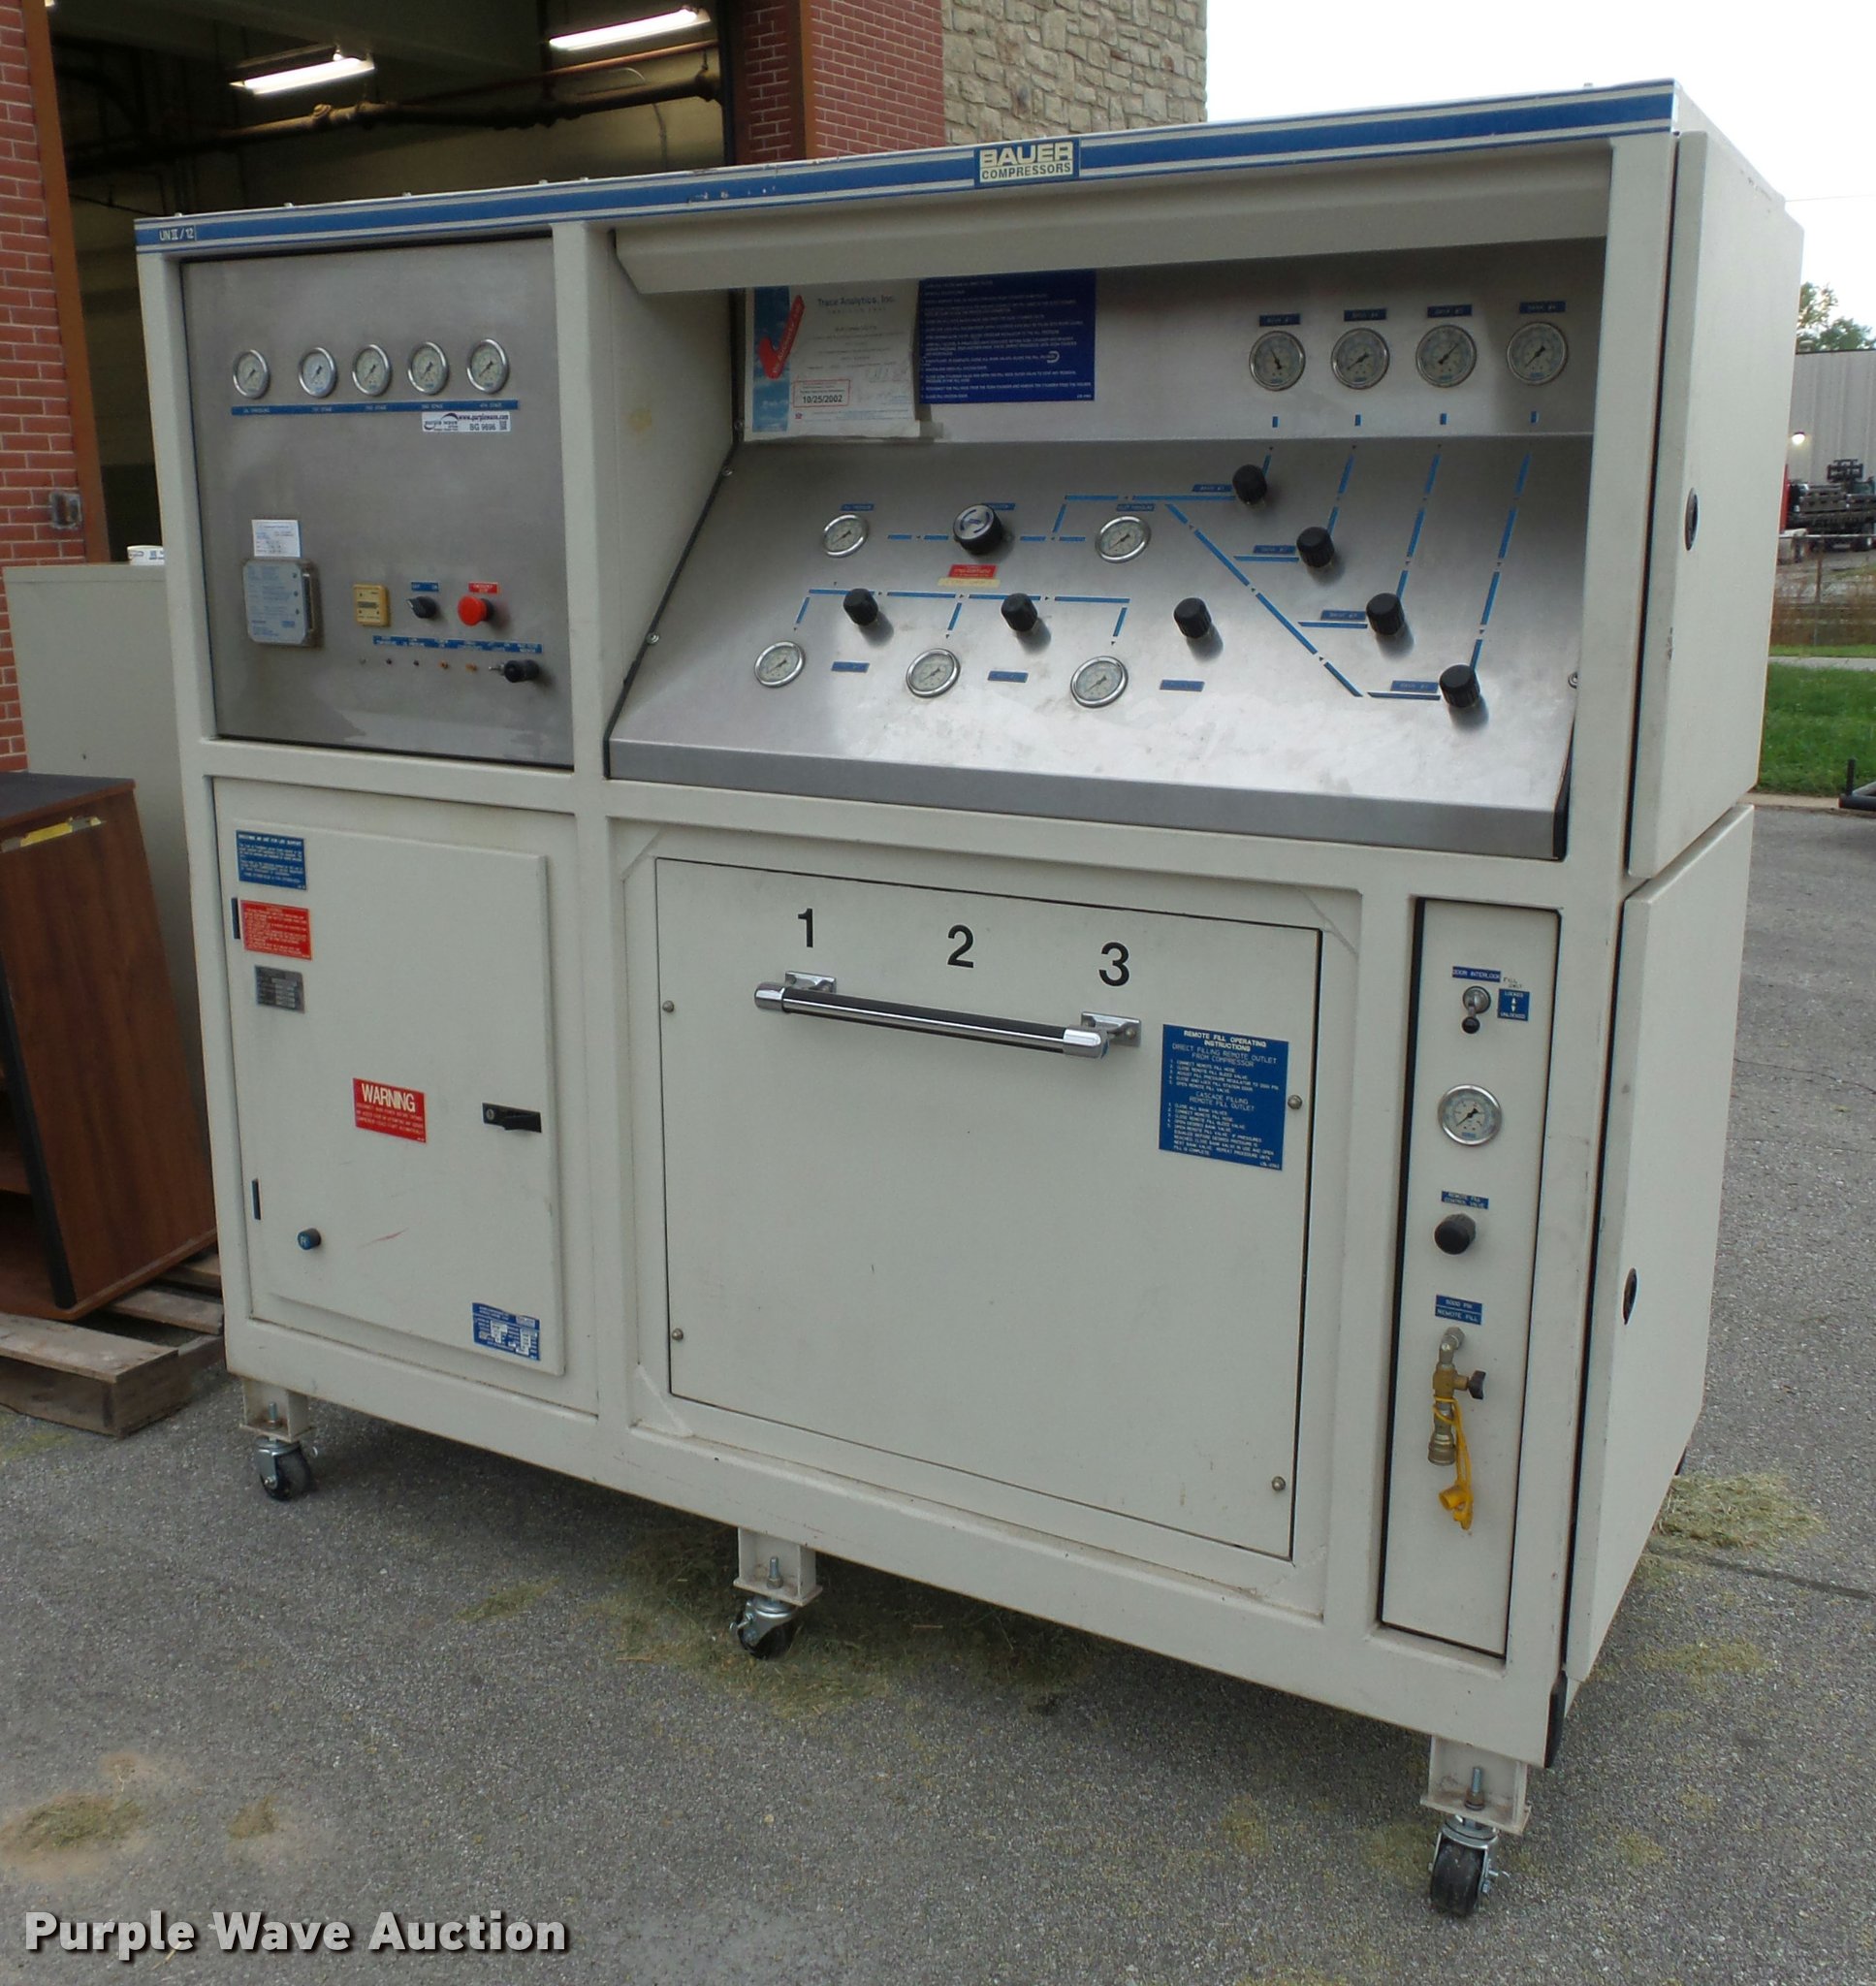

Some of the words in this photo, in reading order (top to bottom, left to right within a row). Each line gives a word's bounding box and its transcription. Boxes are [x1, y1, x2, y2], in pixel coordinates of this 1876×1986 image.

[979, 142, 1073, 167] BAUER
[982, 162, 1071, 179] COMPRESSORS
[803, 395, 843, 403] 10/25/2002
[797, 908, 813, 948] 1
[947, 924, 974, 969] 2
[1098, 942, 1130, 987] 3
[1183, 1030, 1209, 1039] REMOTE
[1229, 1037, 1266, 1047] OPERATING
[1204, 1040, 1250, 1051] INSTRUCTIONS
[1172, 1043, 1193, 1052] DIRECT
[1196, 1047, 1220, 1056] FILLING
[1222, 1050, 1248, 1060] REMOTE
[1251, 1054, 1276, 1064] OUTLET
[1211, 1056, 1253, 1067] COMPRESSOR
[361, 1083, 416, 1113] WARNING
[1196, 1091, 1222, 1100] CASCADE
[1189, 1096, 1212, 1105] REMOTE
[1231, 1103, 1254, 1112] OUTLET
[1437, 1309, 1463, 1319] REMOTE
